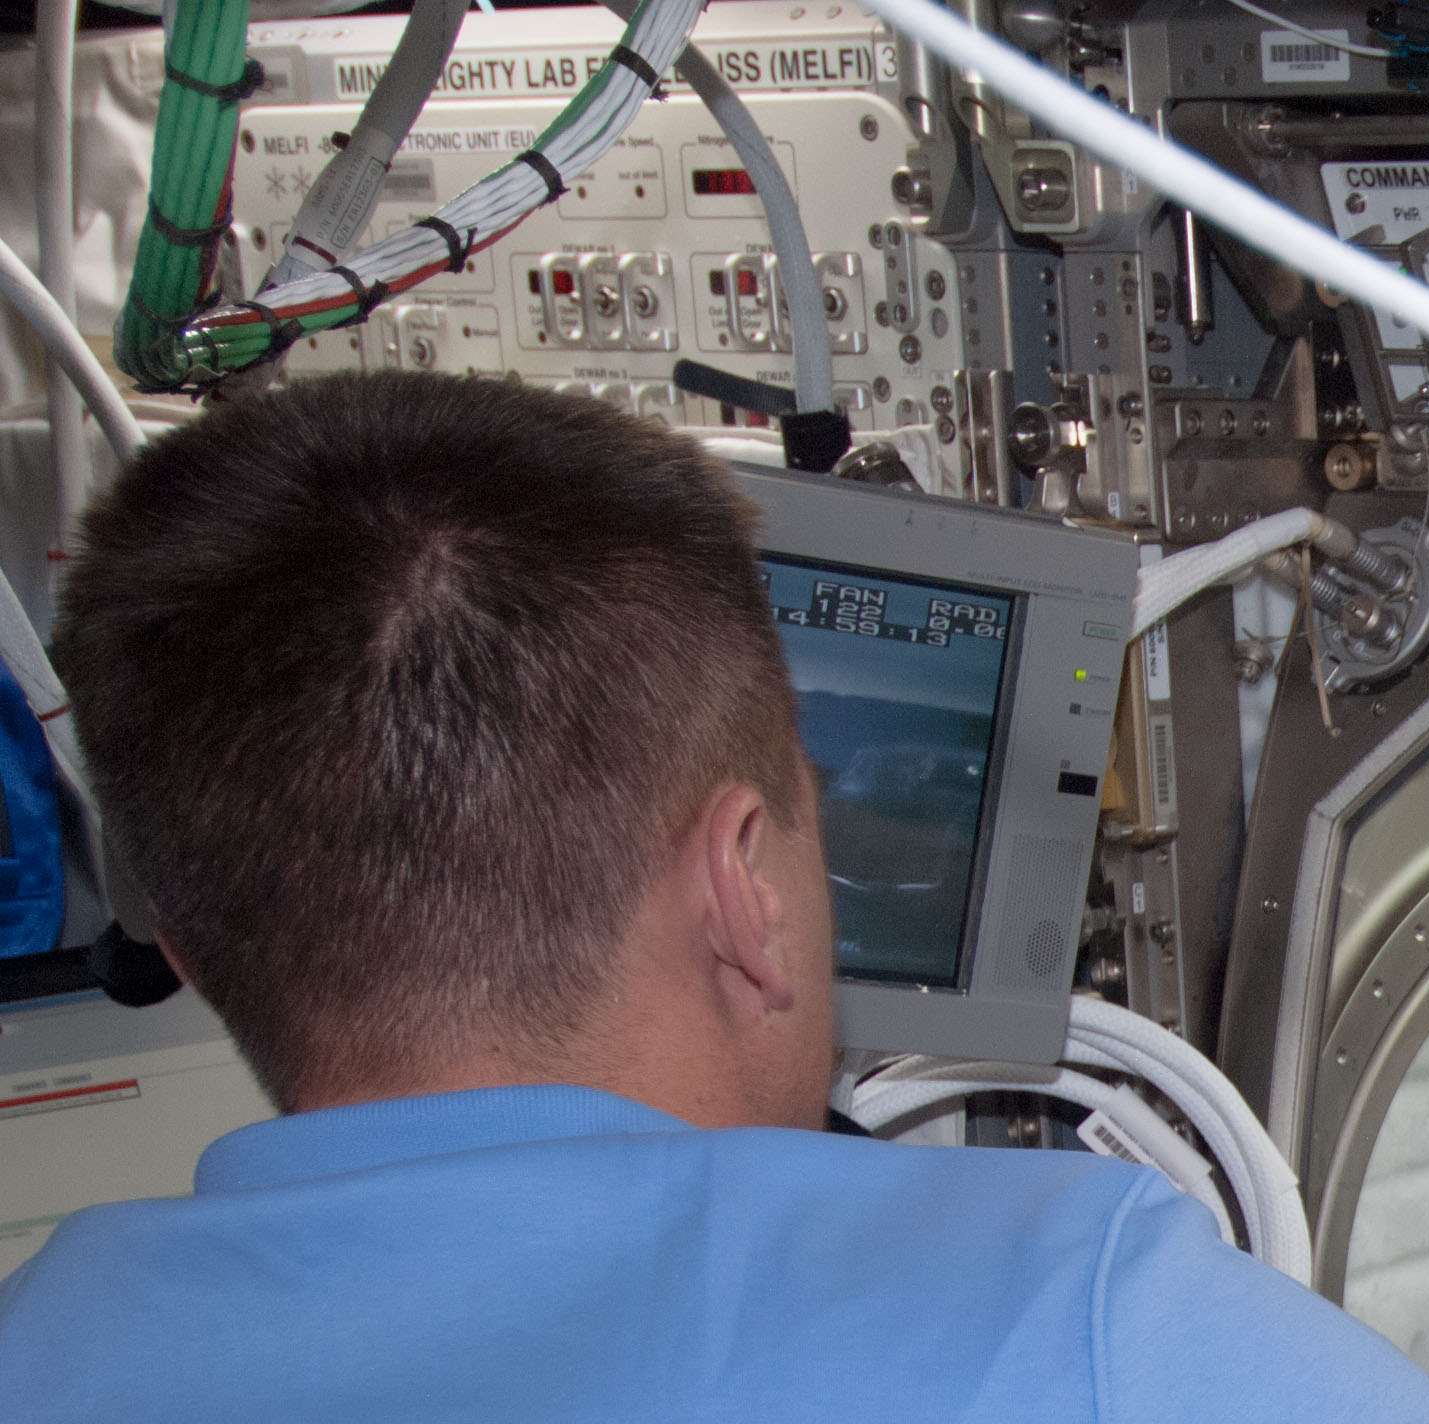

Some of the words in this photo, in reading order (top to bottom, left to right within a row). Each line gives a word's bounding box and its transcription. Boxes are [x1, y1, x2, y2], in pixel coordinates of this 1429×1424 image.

[433, 58, 516, 93] IGHTY
[525, 55, 577, 88] LAB
[770, 46, 873, 84] (MELFI)
[878, 46, 898, 79] 3
[264, 137, 310, 154] MELFI
[466, 131, 500, 149] UNIT
[815, 582, 885, 606] FAN
[930, 600, 998, 624] RAD
[817, 599, 883, 620] 122
